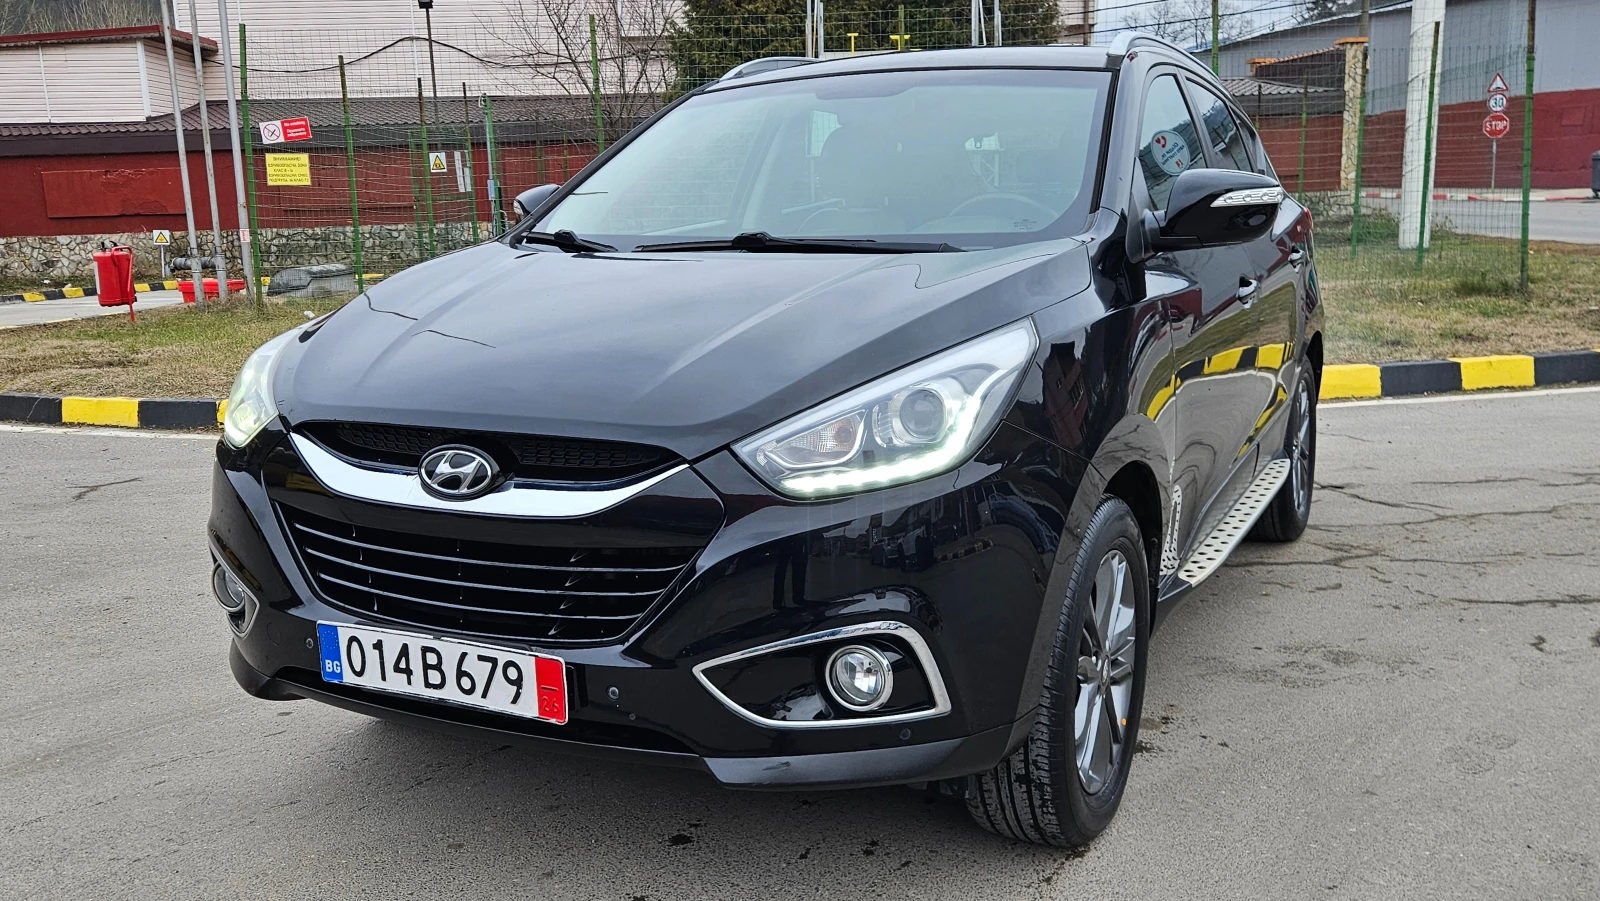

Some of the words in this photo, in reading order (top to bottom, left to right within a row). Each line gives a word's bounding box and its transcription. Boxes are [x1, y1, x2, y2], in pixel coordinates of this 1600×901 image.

[1491, 97, 1504, 108] 30
[1485, 120, 1507, 131] STOP
[325, 659, 341, 674] BG
[346, 635, 524, 704] 014B679
[541, 695, 559, 713] 26
